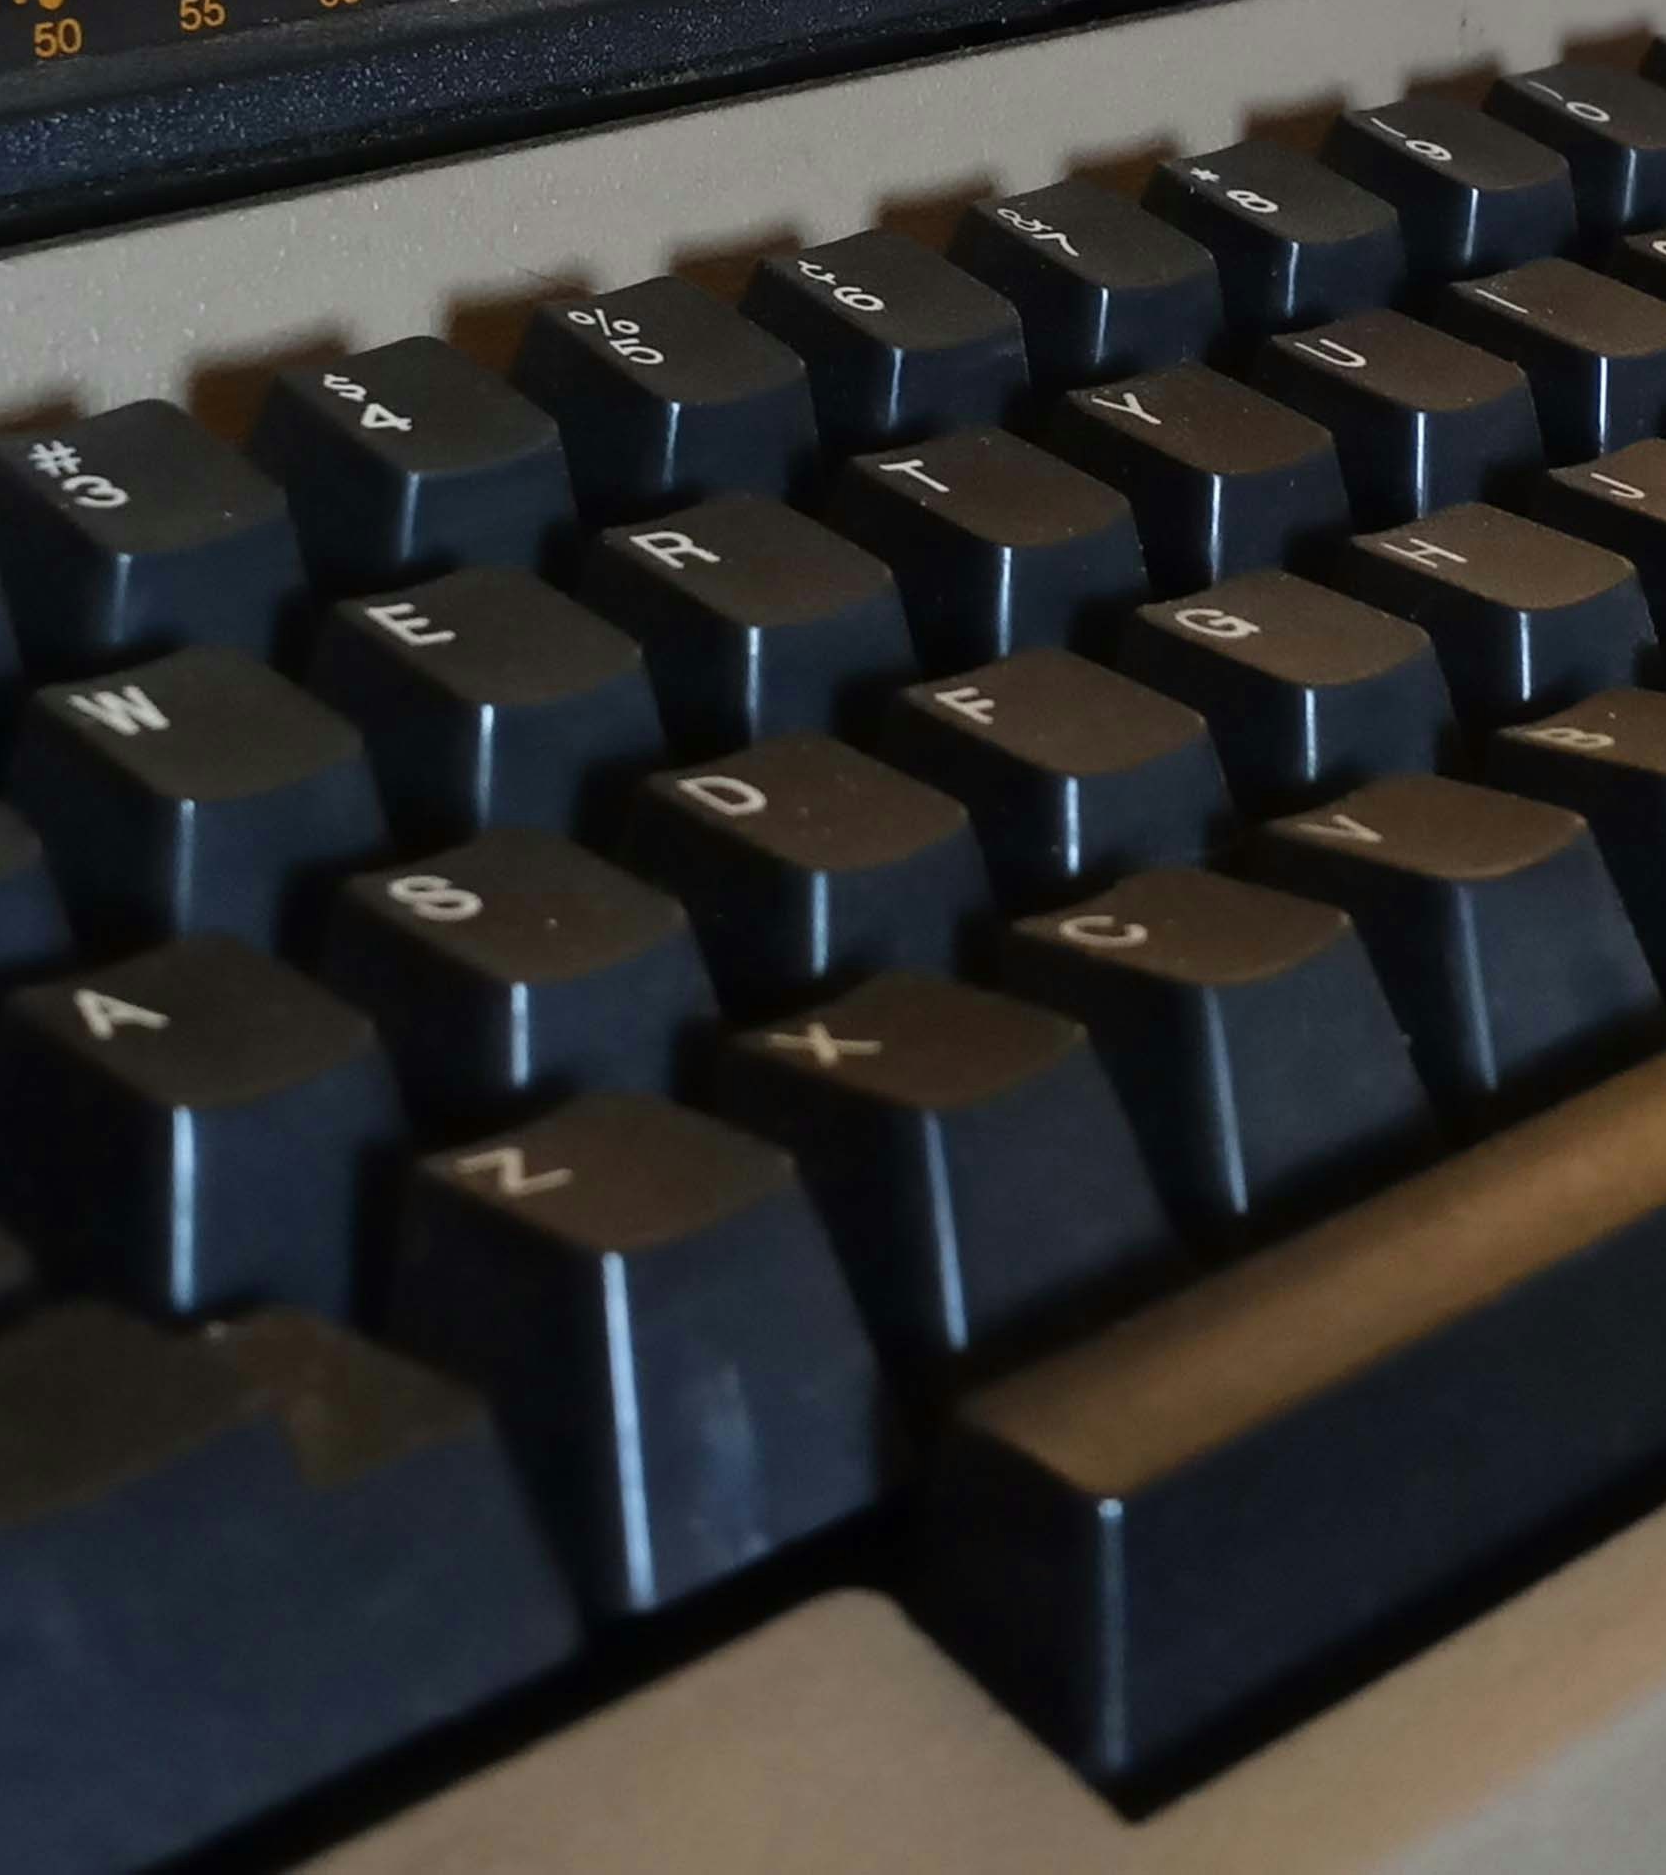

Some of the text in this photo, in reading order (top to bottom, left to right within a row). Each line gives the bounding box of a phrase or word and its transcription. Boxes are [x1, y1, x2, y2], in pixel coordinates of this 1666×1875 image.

[34, 18, 82, 58] 50
[1405, 140, 1452, 161] 9
[1226, 189, 1279, 214] 8
[997, 208, 1053, 232] &
[1032, 232, 1079, 257] 7
[833, 286, 884, 311] 6
[1475, 288, 1529, 314] I
[567, 308, 640, 337] %
[609, 338, 664, 365] 5
[1295, 338, 1367, 368] U
[360, 403, 412, 431] 4
[1091, 392, 1162, 425] Y
[30, 440, 81, 476] #
[62, 475, 128, 508] 3
[879, 459, 950, 493] T
[1590, 472, 1645, 499] J
[630, 531, 720, 569] R
[1383, 538, 1467, 569] H
[366, 603, 455, 645] E
[1175, 608, 1260, 639] G
[71, 685, 168, 734] W
[935, 687, 995, 724] F
[1526, 727, 1615, 750] B
[680, 776, 767, 815] D
[1298, 813, 1384, 845] V
[389, 875, 482, 920] S
[1059, 915, 1148, 946] C
[76, 990, 167, 1037] A
[764, 1023, 881, 1068] X
[456, 1145, 572, 1197] Z
